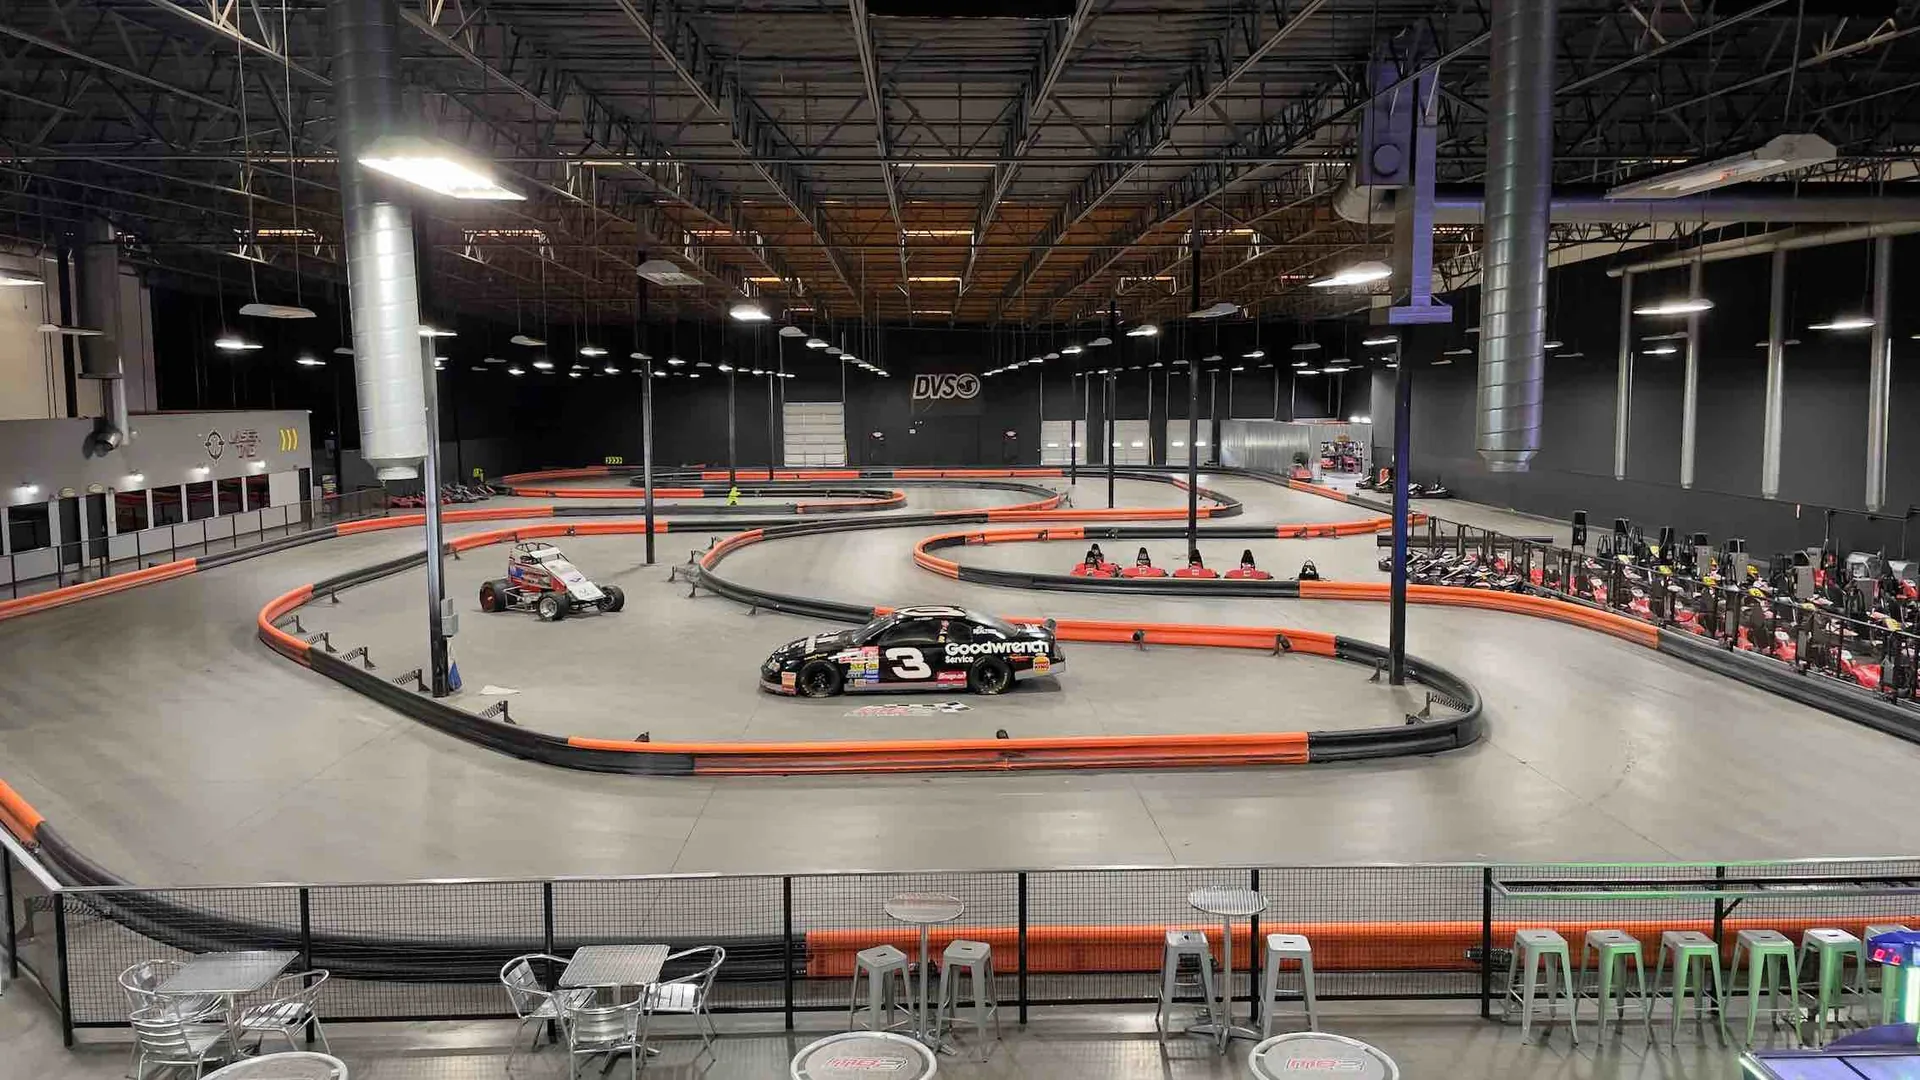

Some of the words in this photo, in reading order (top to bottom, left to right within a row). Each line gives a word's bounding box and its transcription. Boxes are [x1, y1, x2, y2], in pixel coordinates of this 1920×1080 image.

[913, 373, 957, 399] DVS
[945, 640, 1049, 656] Goodwrench
[885, 647, 932, 679] 3
[945, 655, 974, 664] Service
